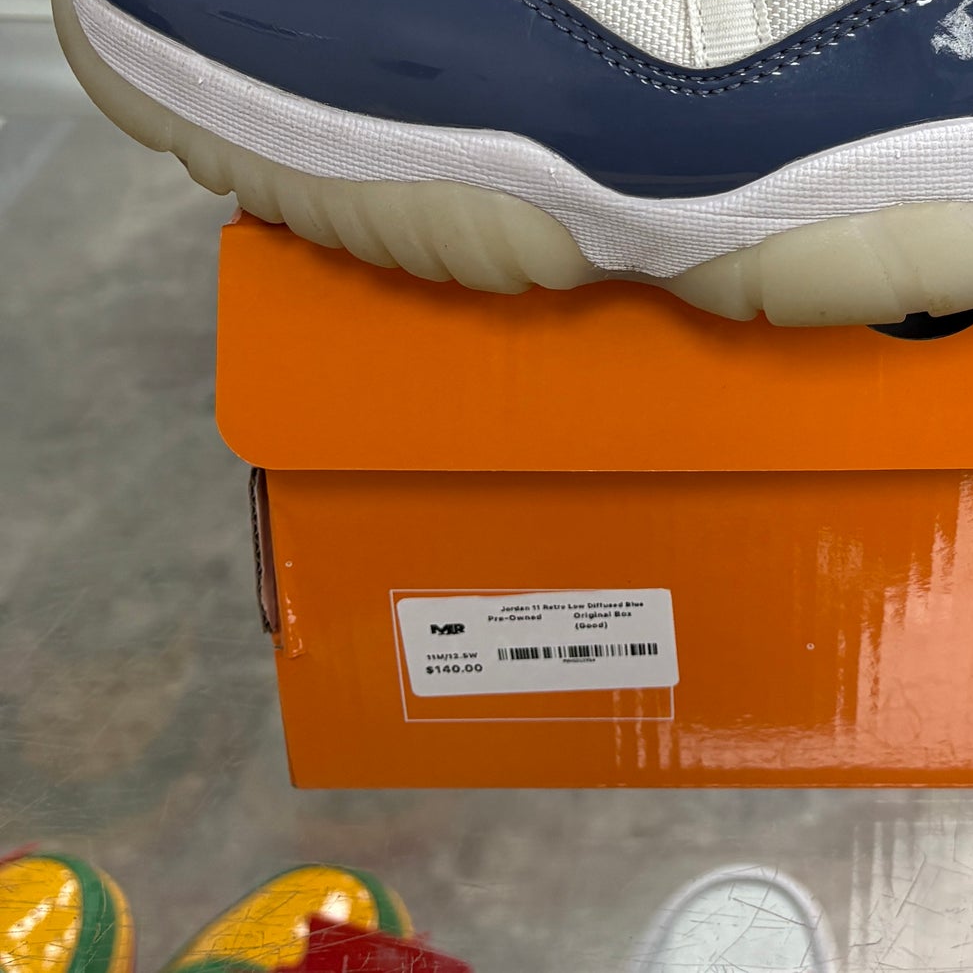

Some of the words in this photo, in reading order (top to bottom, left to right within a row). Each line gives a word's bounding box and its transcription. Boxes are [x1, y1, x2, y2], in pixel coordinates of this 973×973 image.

[500, 605, 531, 613] Jordan
[542, 603, 566, 611] Retro
[587, 601, 623, 609] Diffused
[487, 613, 543, 622] Pre-Owned
[573, 611, 612, 619] Original
[574, 621, 608, 630] (Good)
[425, 664, 484, 675] $140.00
